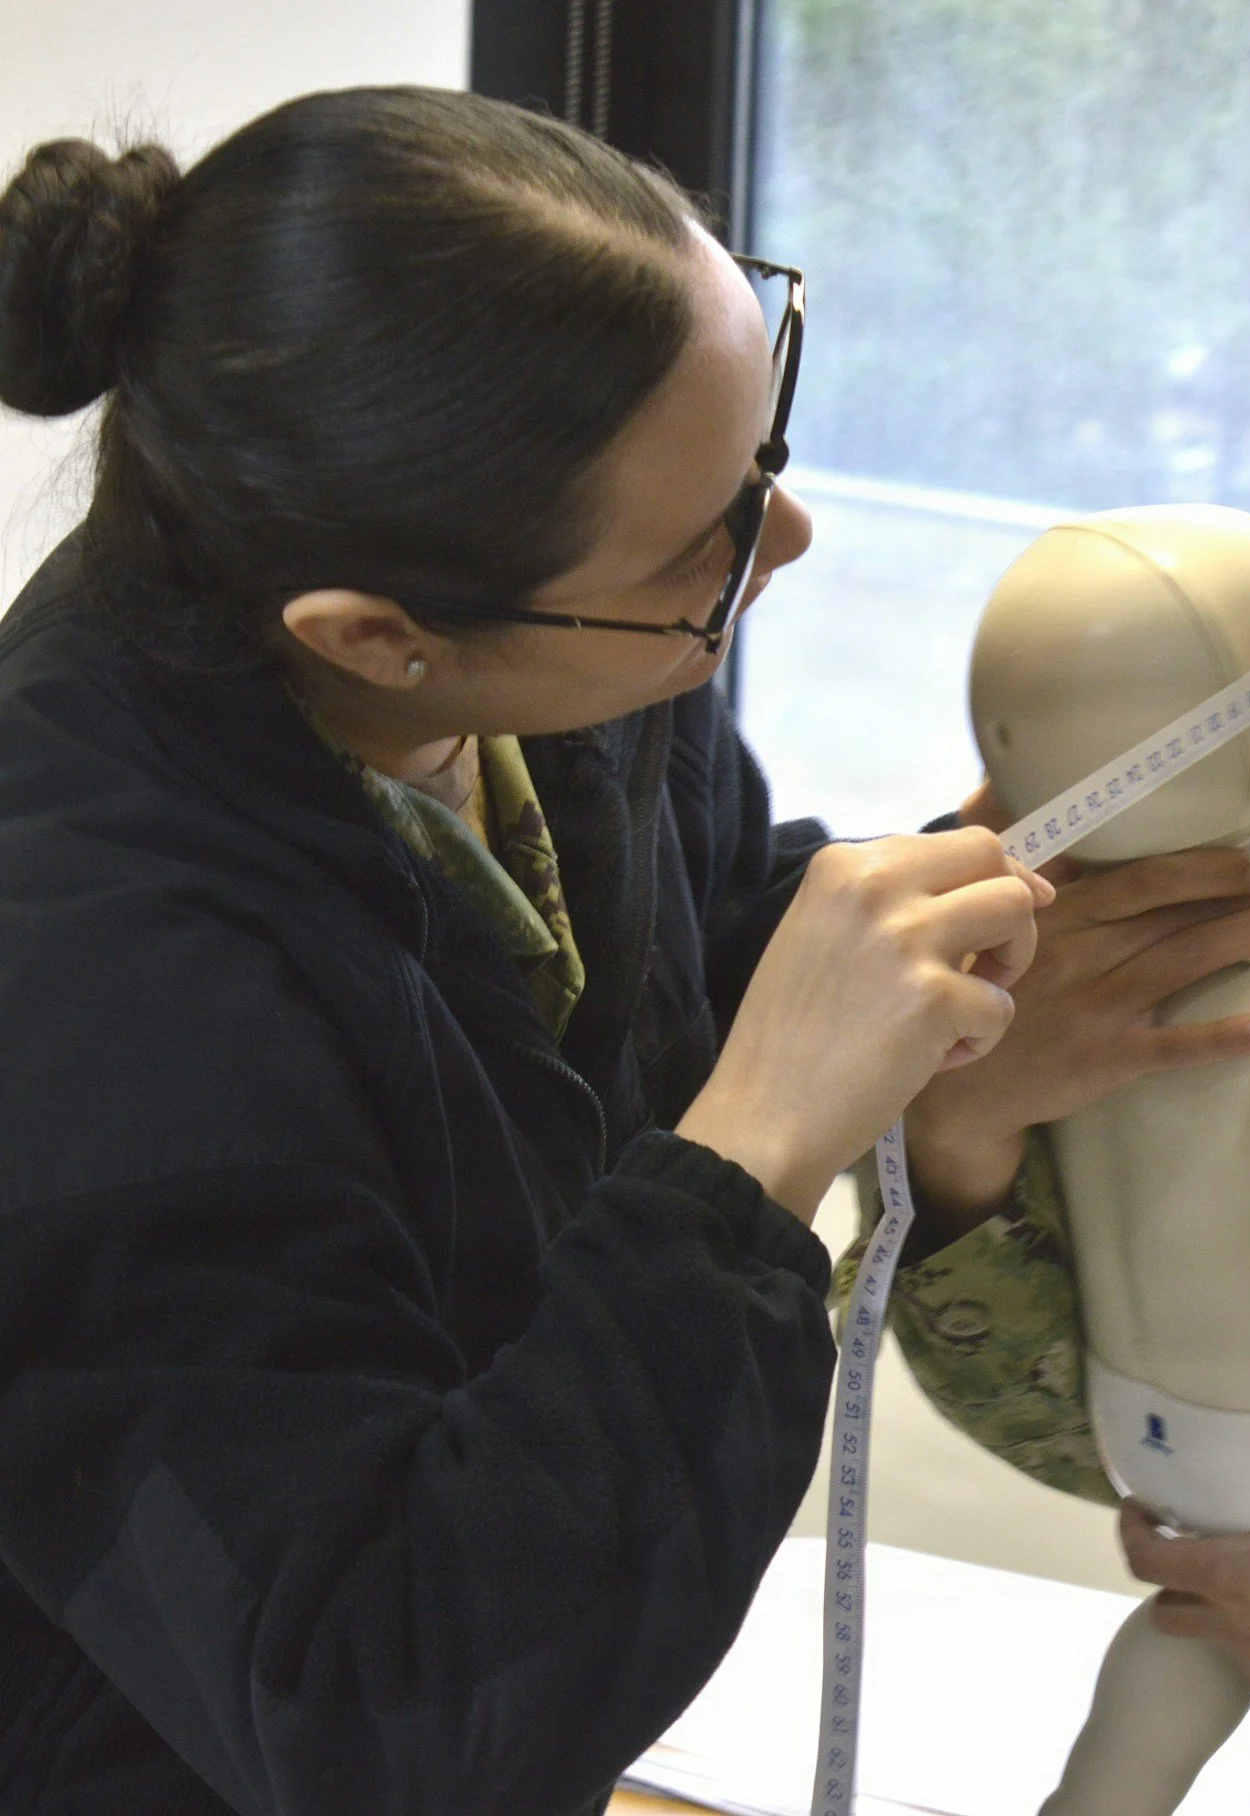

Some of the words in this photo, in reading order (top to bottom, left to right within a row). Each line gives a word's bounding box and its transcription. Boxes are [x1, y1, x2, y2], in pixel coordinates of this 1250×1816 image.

[1025, 832, 1040, 853] 29
[885, 1155, 897, 1175] 43
[890, 1186, 902, 1207] 44
[884, 1217, 898, 1235] 45
[873, 1244, 887, 1264] 46
[864, 1275, 877, 1296] 47
[856, 1305, 870, 1326] 48
[852, 1337, 865, 1358] 49
[847, 1369, 862, 1391] 50
[845, 1401, 860, 1419] 51
[842, 1432, 858, 1454] 52
[841, 1464, 856, 1485] 53
[839, 1496, 855, 1517] 54
[838, 1527, 854, 1549] 55
[836, 1559, 852, 1580] 56
[836, 1590, 852, 1612] 57
[836, 1621, 852, 1641] 58
[835, 1652, 851, 1675] 59
[832, 1683, 849, 1706] 60
